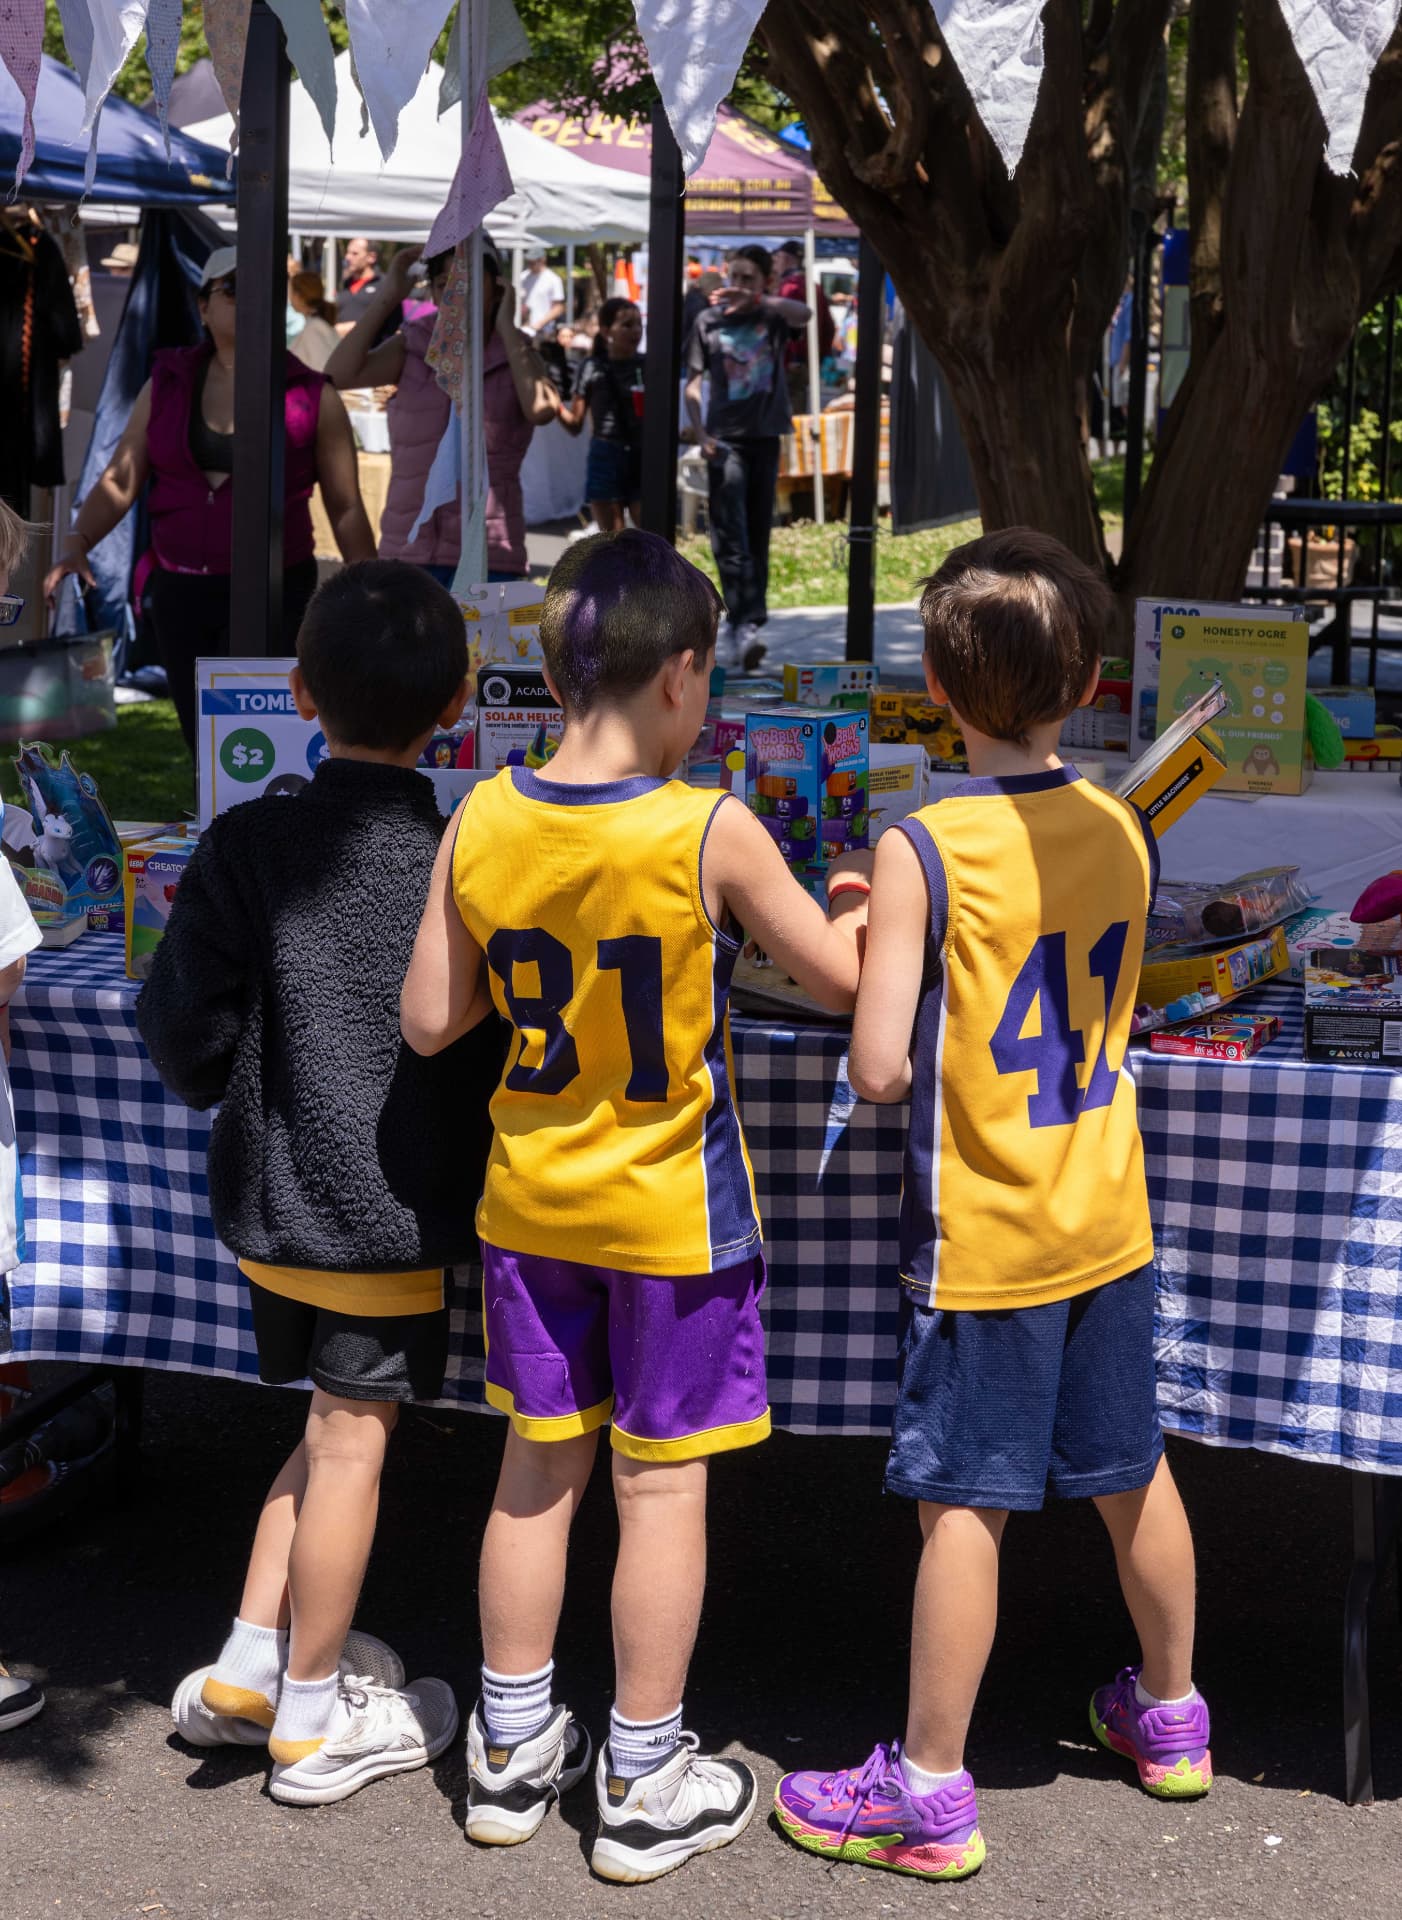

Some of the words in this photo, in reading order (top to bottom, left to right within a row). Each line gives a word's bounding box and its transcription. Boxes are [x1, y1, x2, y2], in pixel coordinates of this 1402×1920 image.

[531, 111, 652, 149] PERE
[1203, 626, 1253, 638] HONESTY
[1257, 629, 1287, 640] OGRE
[881, 701, 897, 711] CAT
[485, 711, 523, 721] SOLAR
[750, 727, 801, 746] WOBBLY
[232, 742, 265, 769] $2
[1147, 799, 1164, 816] LITTLE
[486, 926, 669, 1102] 81
[989, 919, 1130, 1128] 41
